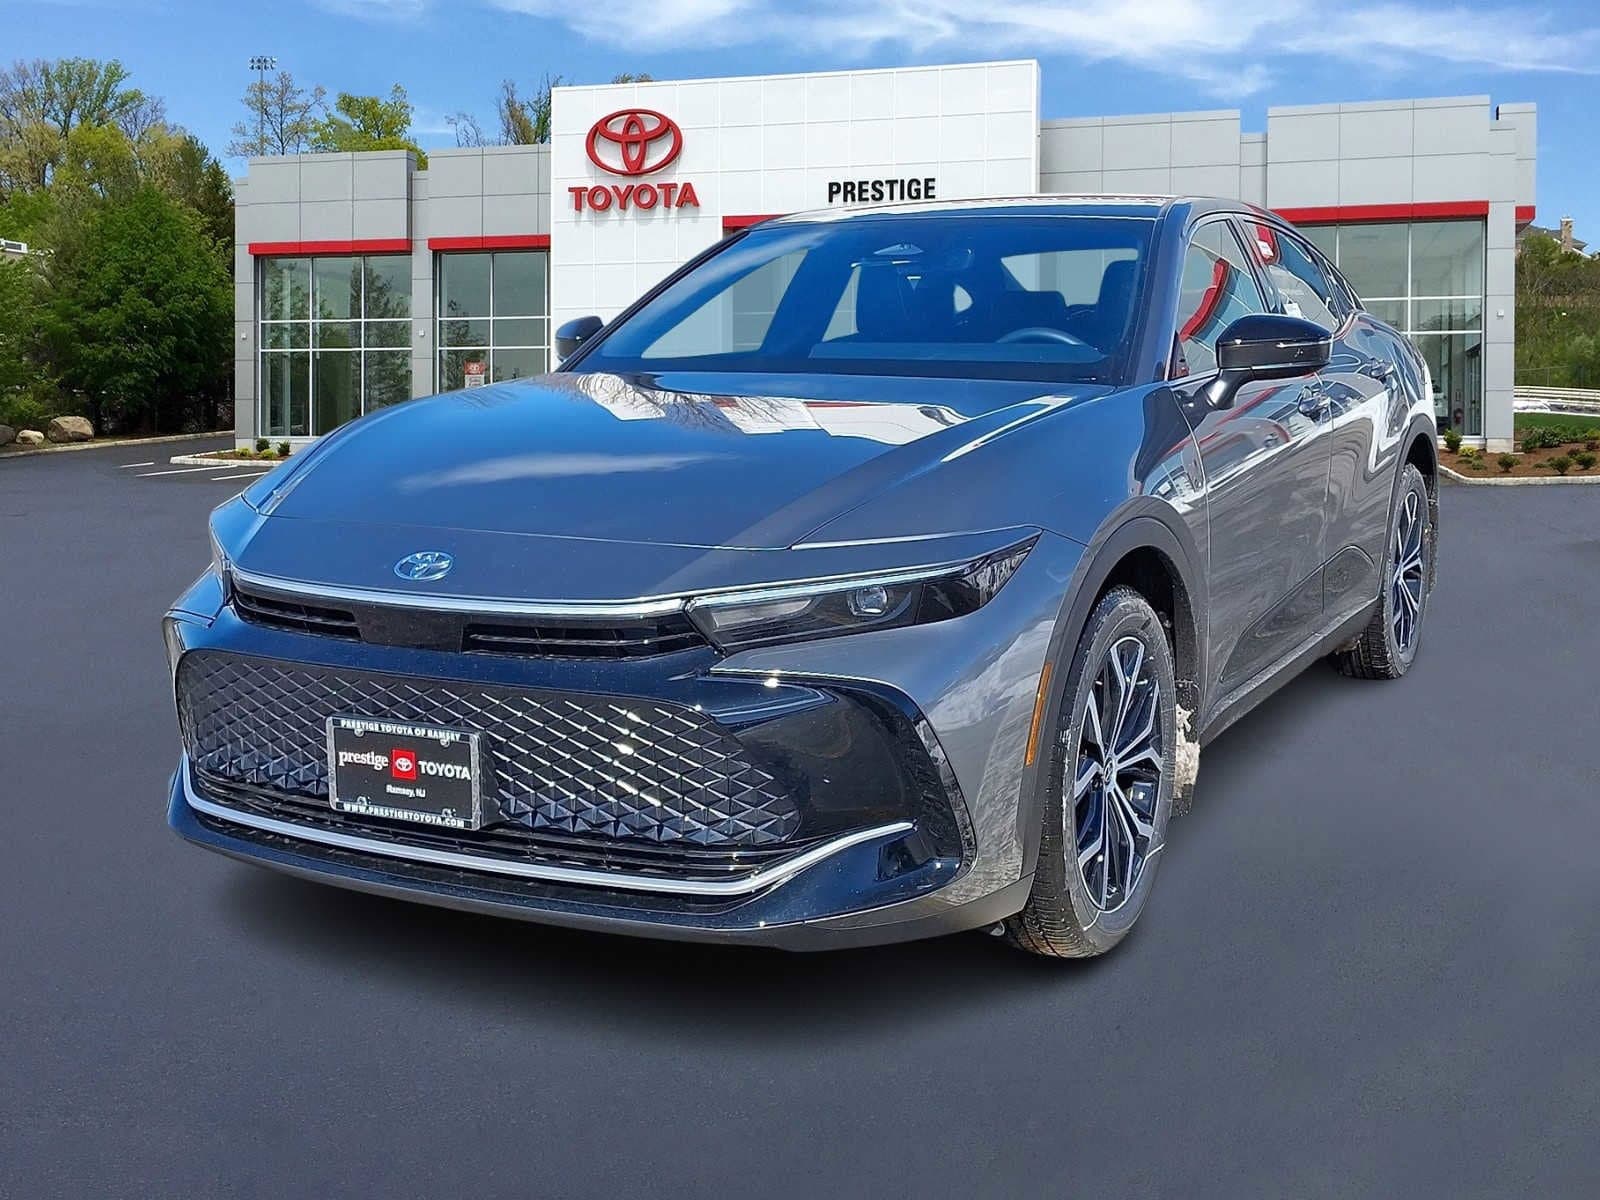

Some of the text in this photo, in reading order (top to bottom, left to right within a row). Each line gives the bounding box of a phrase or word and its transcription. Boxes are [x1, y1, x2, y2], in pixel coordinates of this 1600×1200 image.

[567, 182, 699, 212] TOYOTA
[828, 178, 936, 203] PRESTIGE
[341, 719, 461, 741] PRESTIGE TOYOTA OF RAMSEY
[338, 751, 471, 780] prestige TOYOTA
[415, 788, 426, 798] NJ
[343, 803, 464, 828] WWW.PRESTIGETOYOTA.COM
